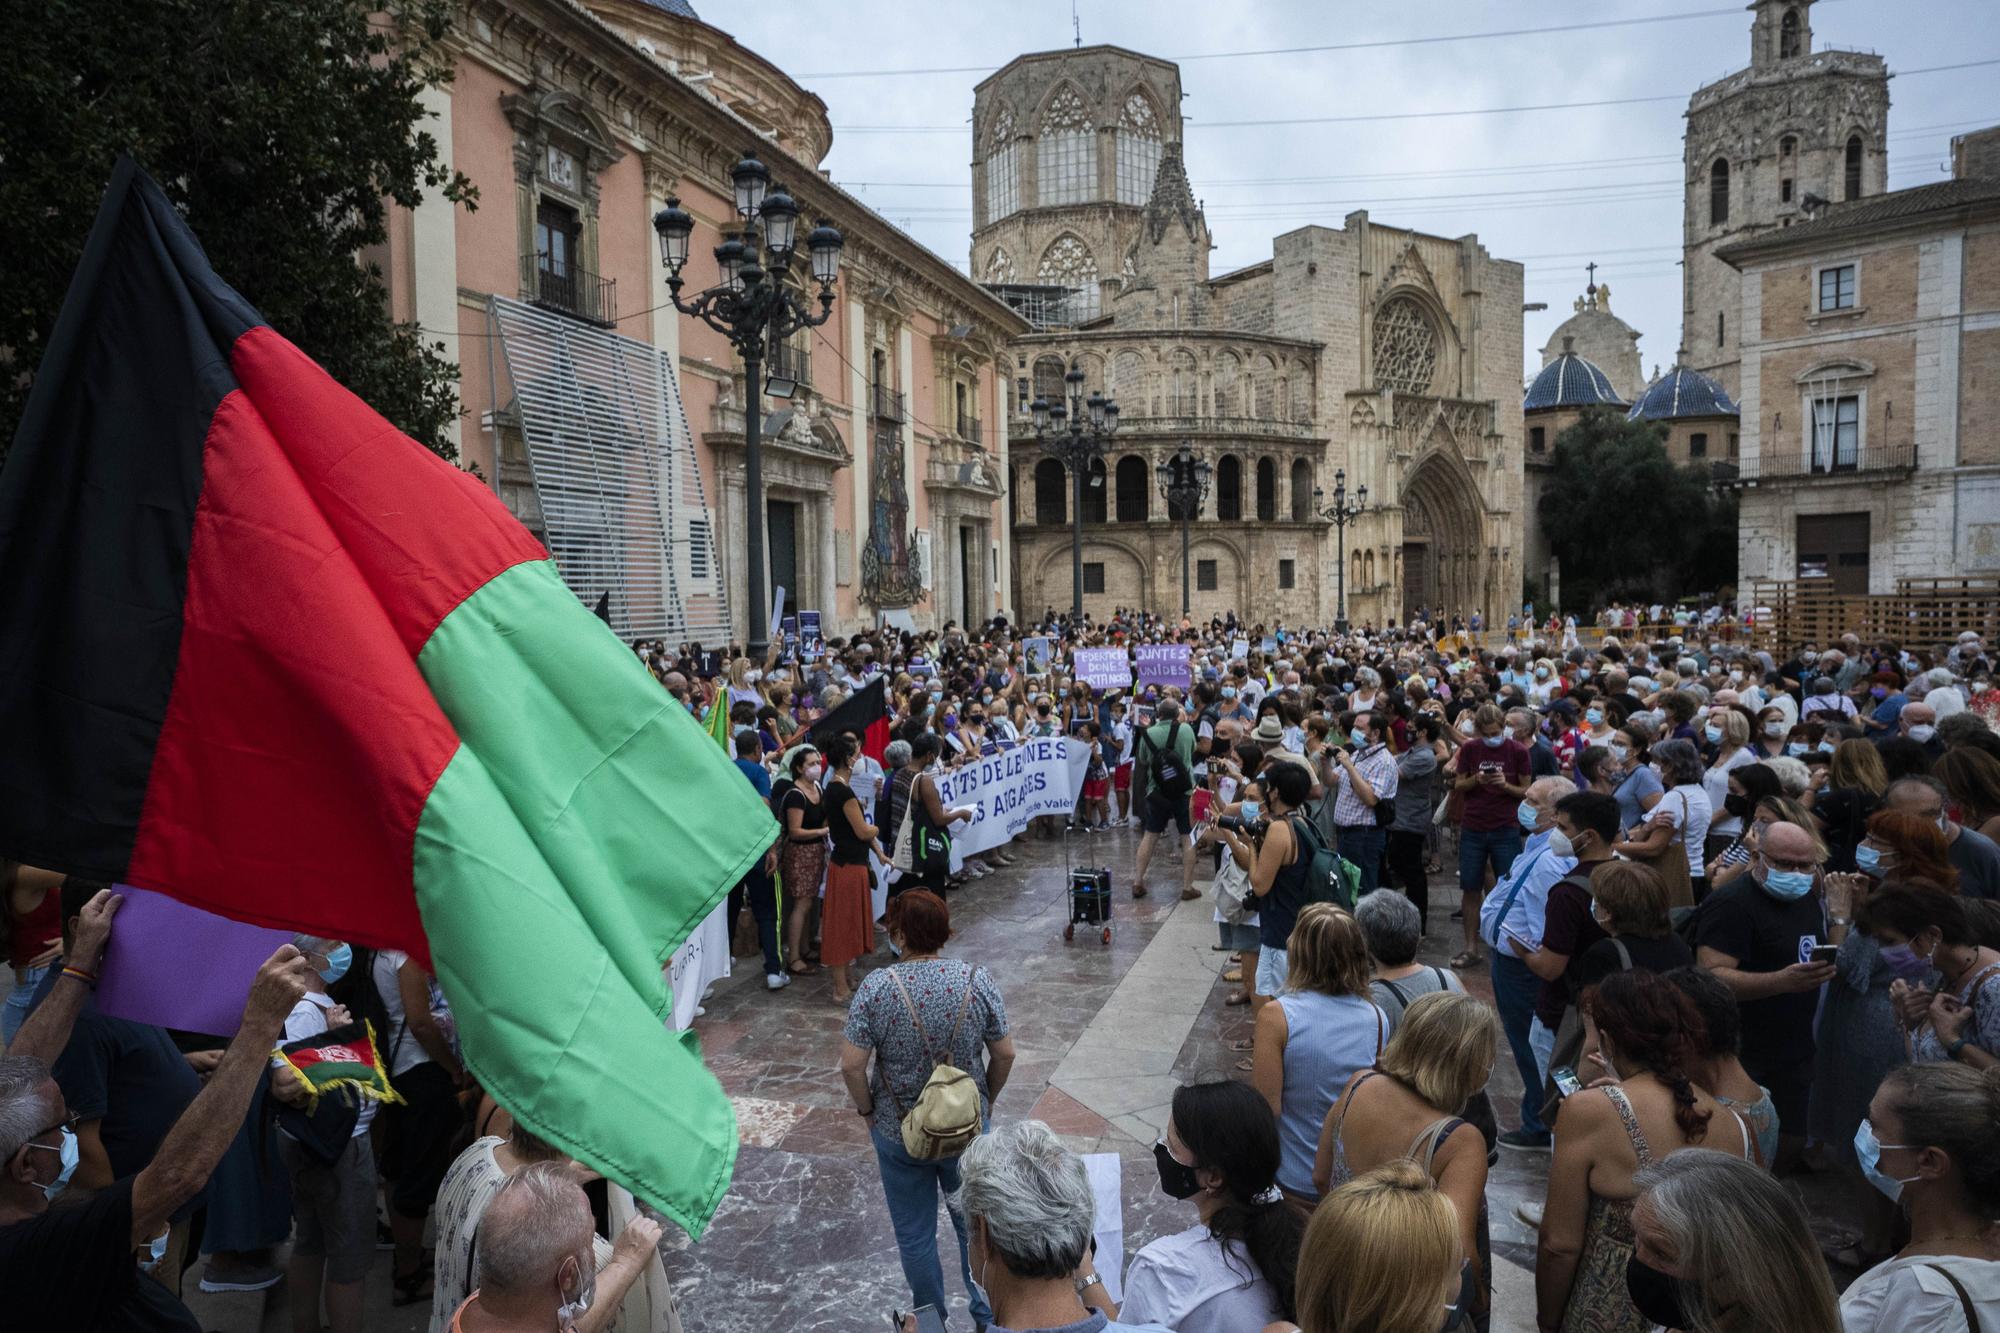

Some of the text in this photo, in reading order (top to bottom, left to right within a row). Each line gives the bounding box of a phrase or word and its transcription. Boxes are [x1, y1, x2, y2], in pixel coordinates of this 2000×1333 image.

[1137, 648, 1187, 661] JUNTES
[1088, 662, 1124, 672] DONES
[1138, 663, 1187, 676] UNIDES
[941, 768, 978, 804] RTS
[982, 760, 1004, 785] DE
[1006, 754, 1024, 777] LE
